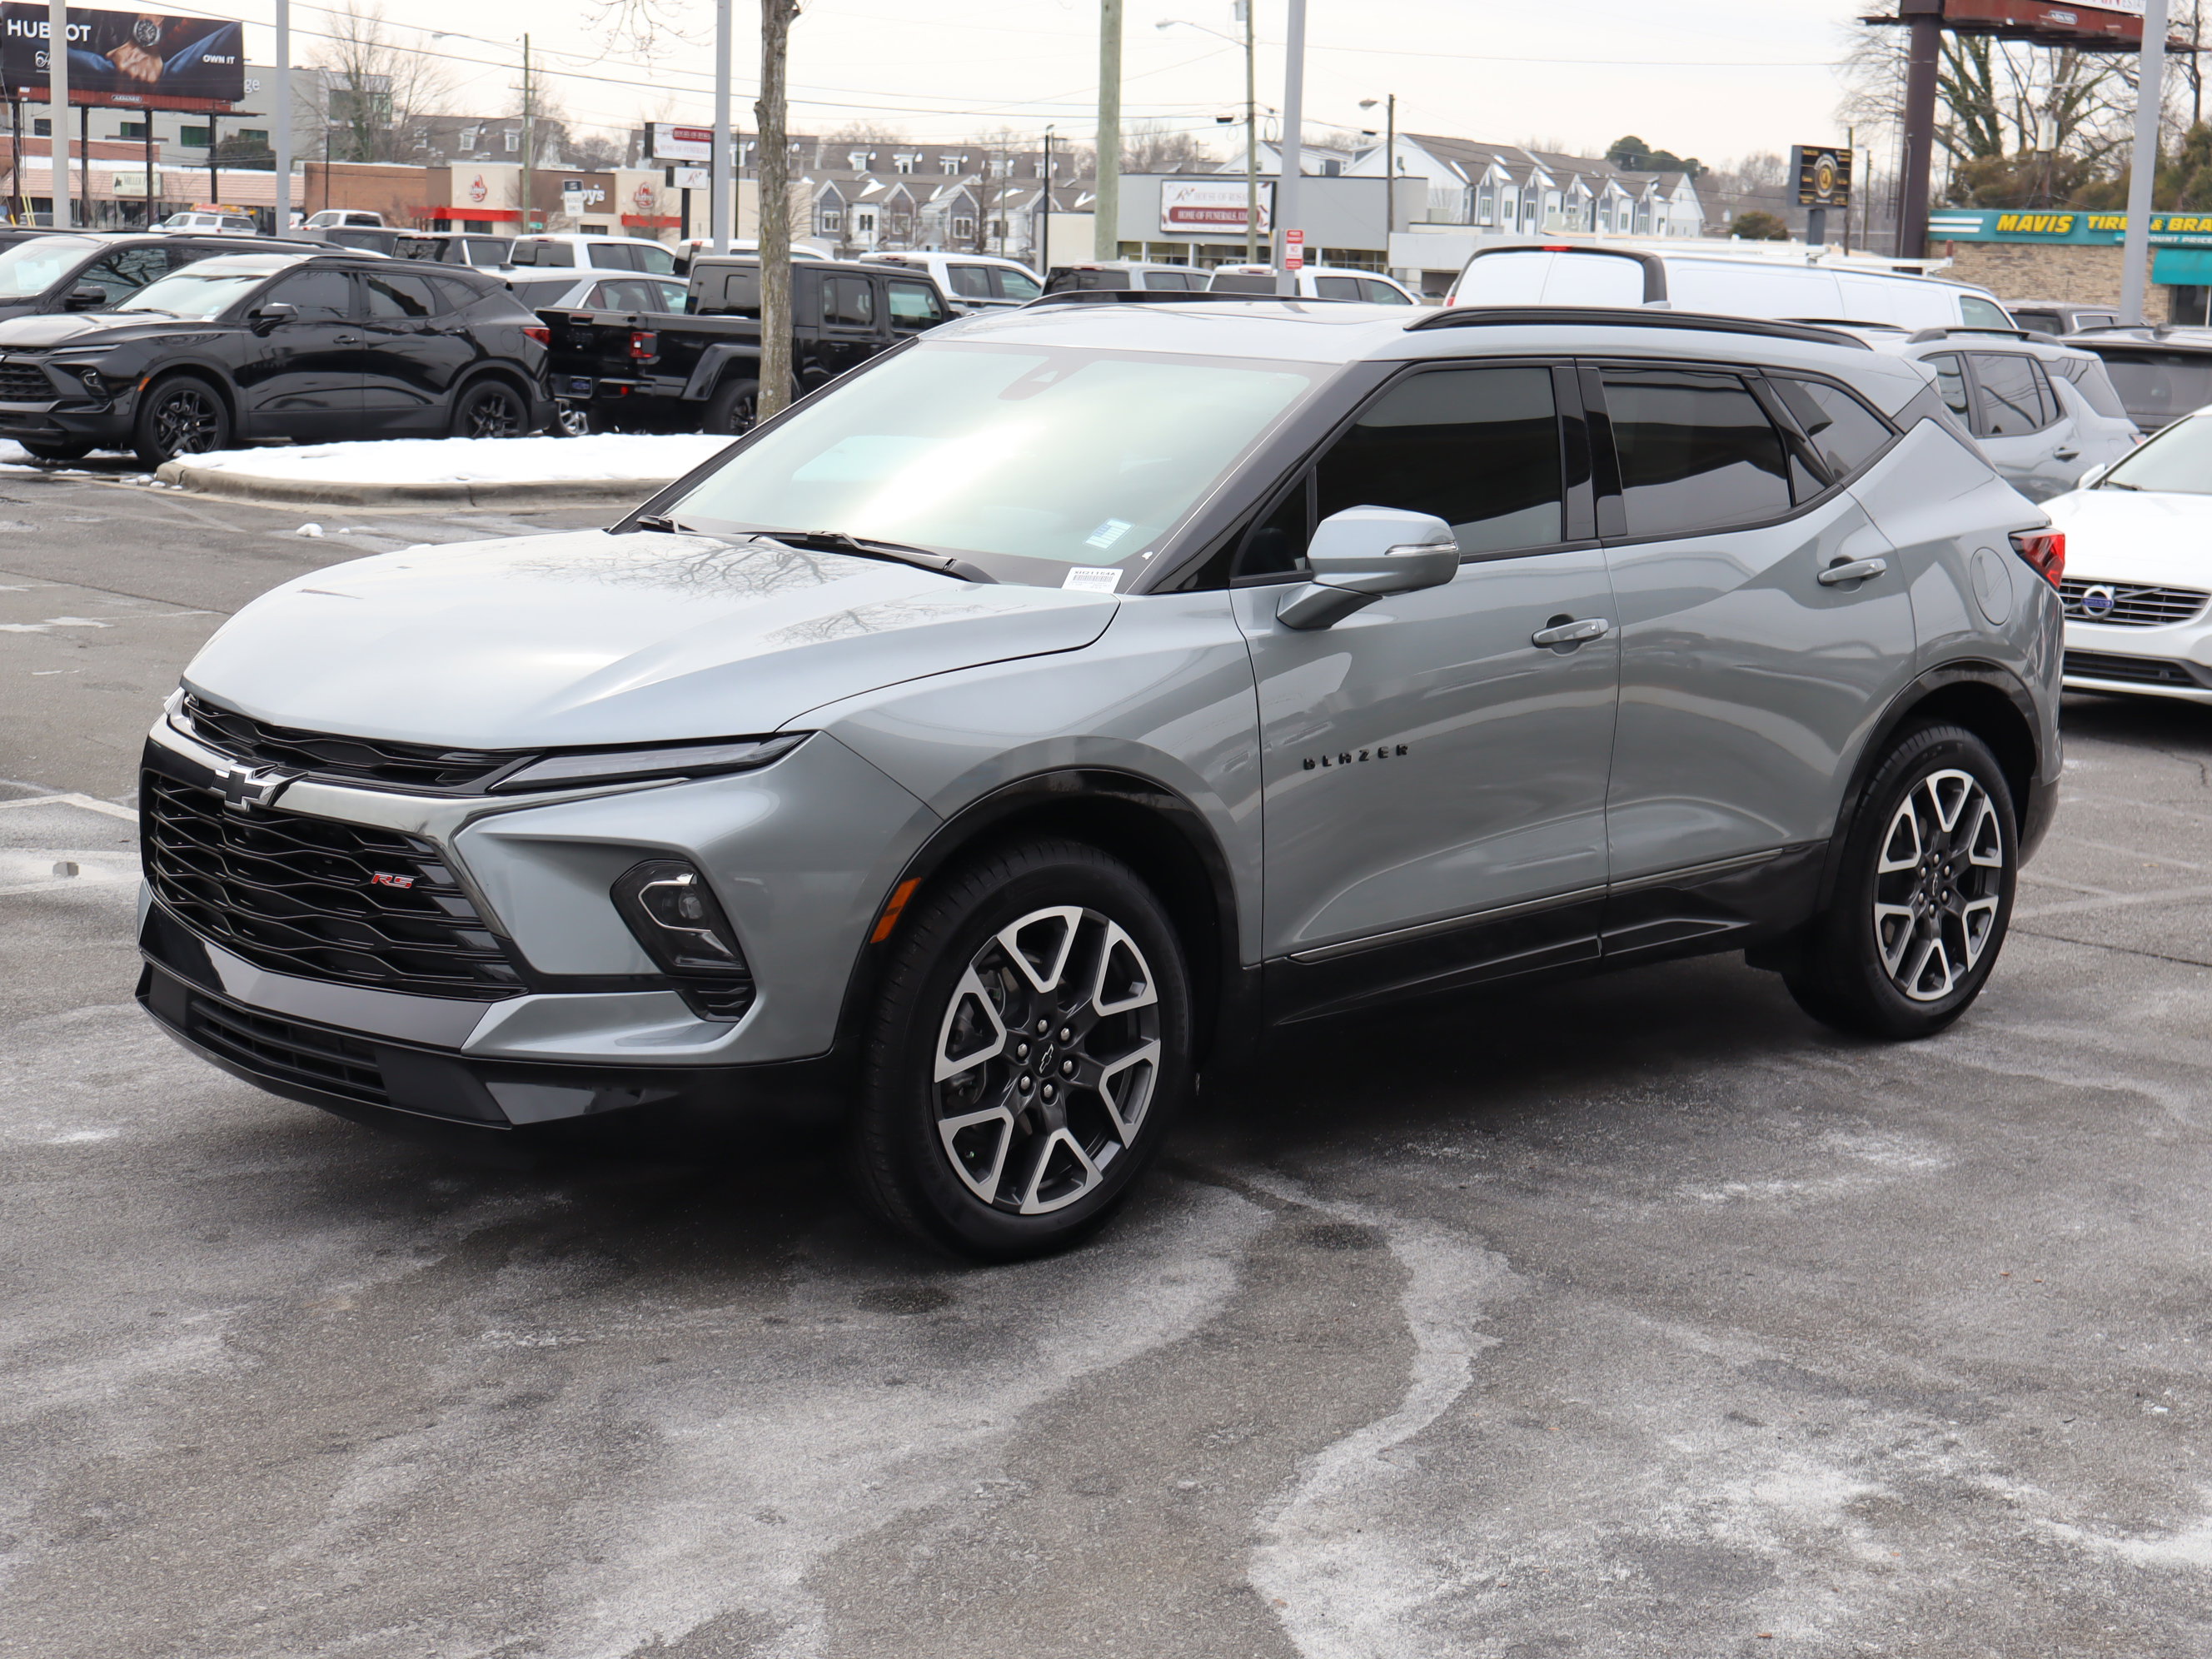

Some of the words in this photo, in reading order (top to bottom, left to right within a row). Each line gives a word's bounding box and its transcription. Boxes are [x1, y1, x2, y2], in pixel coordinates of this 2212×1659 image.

[7, 19, 92, 42] HUBOT
[202, 54, 225, 64] OWN
[226, 56, 236, 65] IT
[1996, 214, 2074, 233] MAVIS
[2150, 218, 2163, 231] &
[1303, 743, 1409, 770] BLAZER
[371, 873, 415, 889] RS
